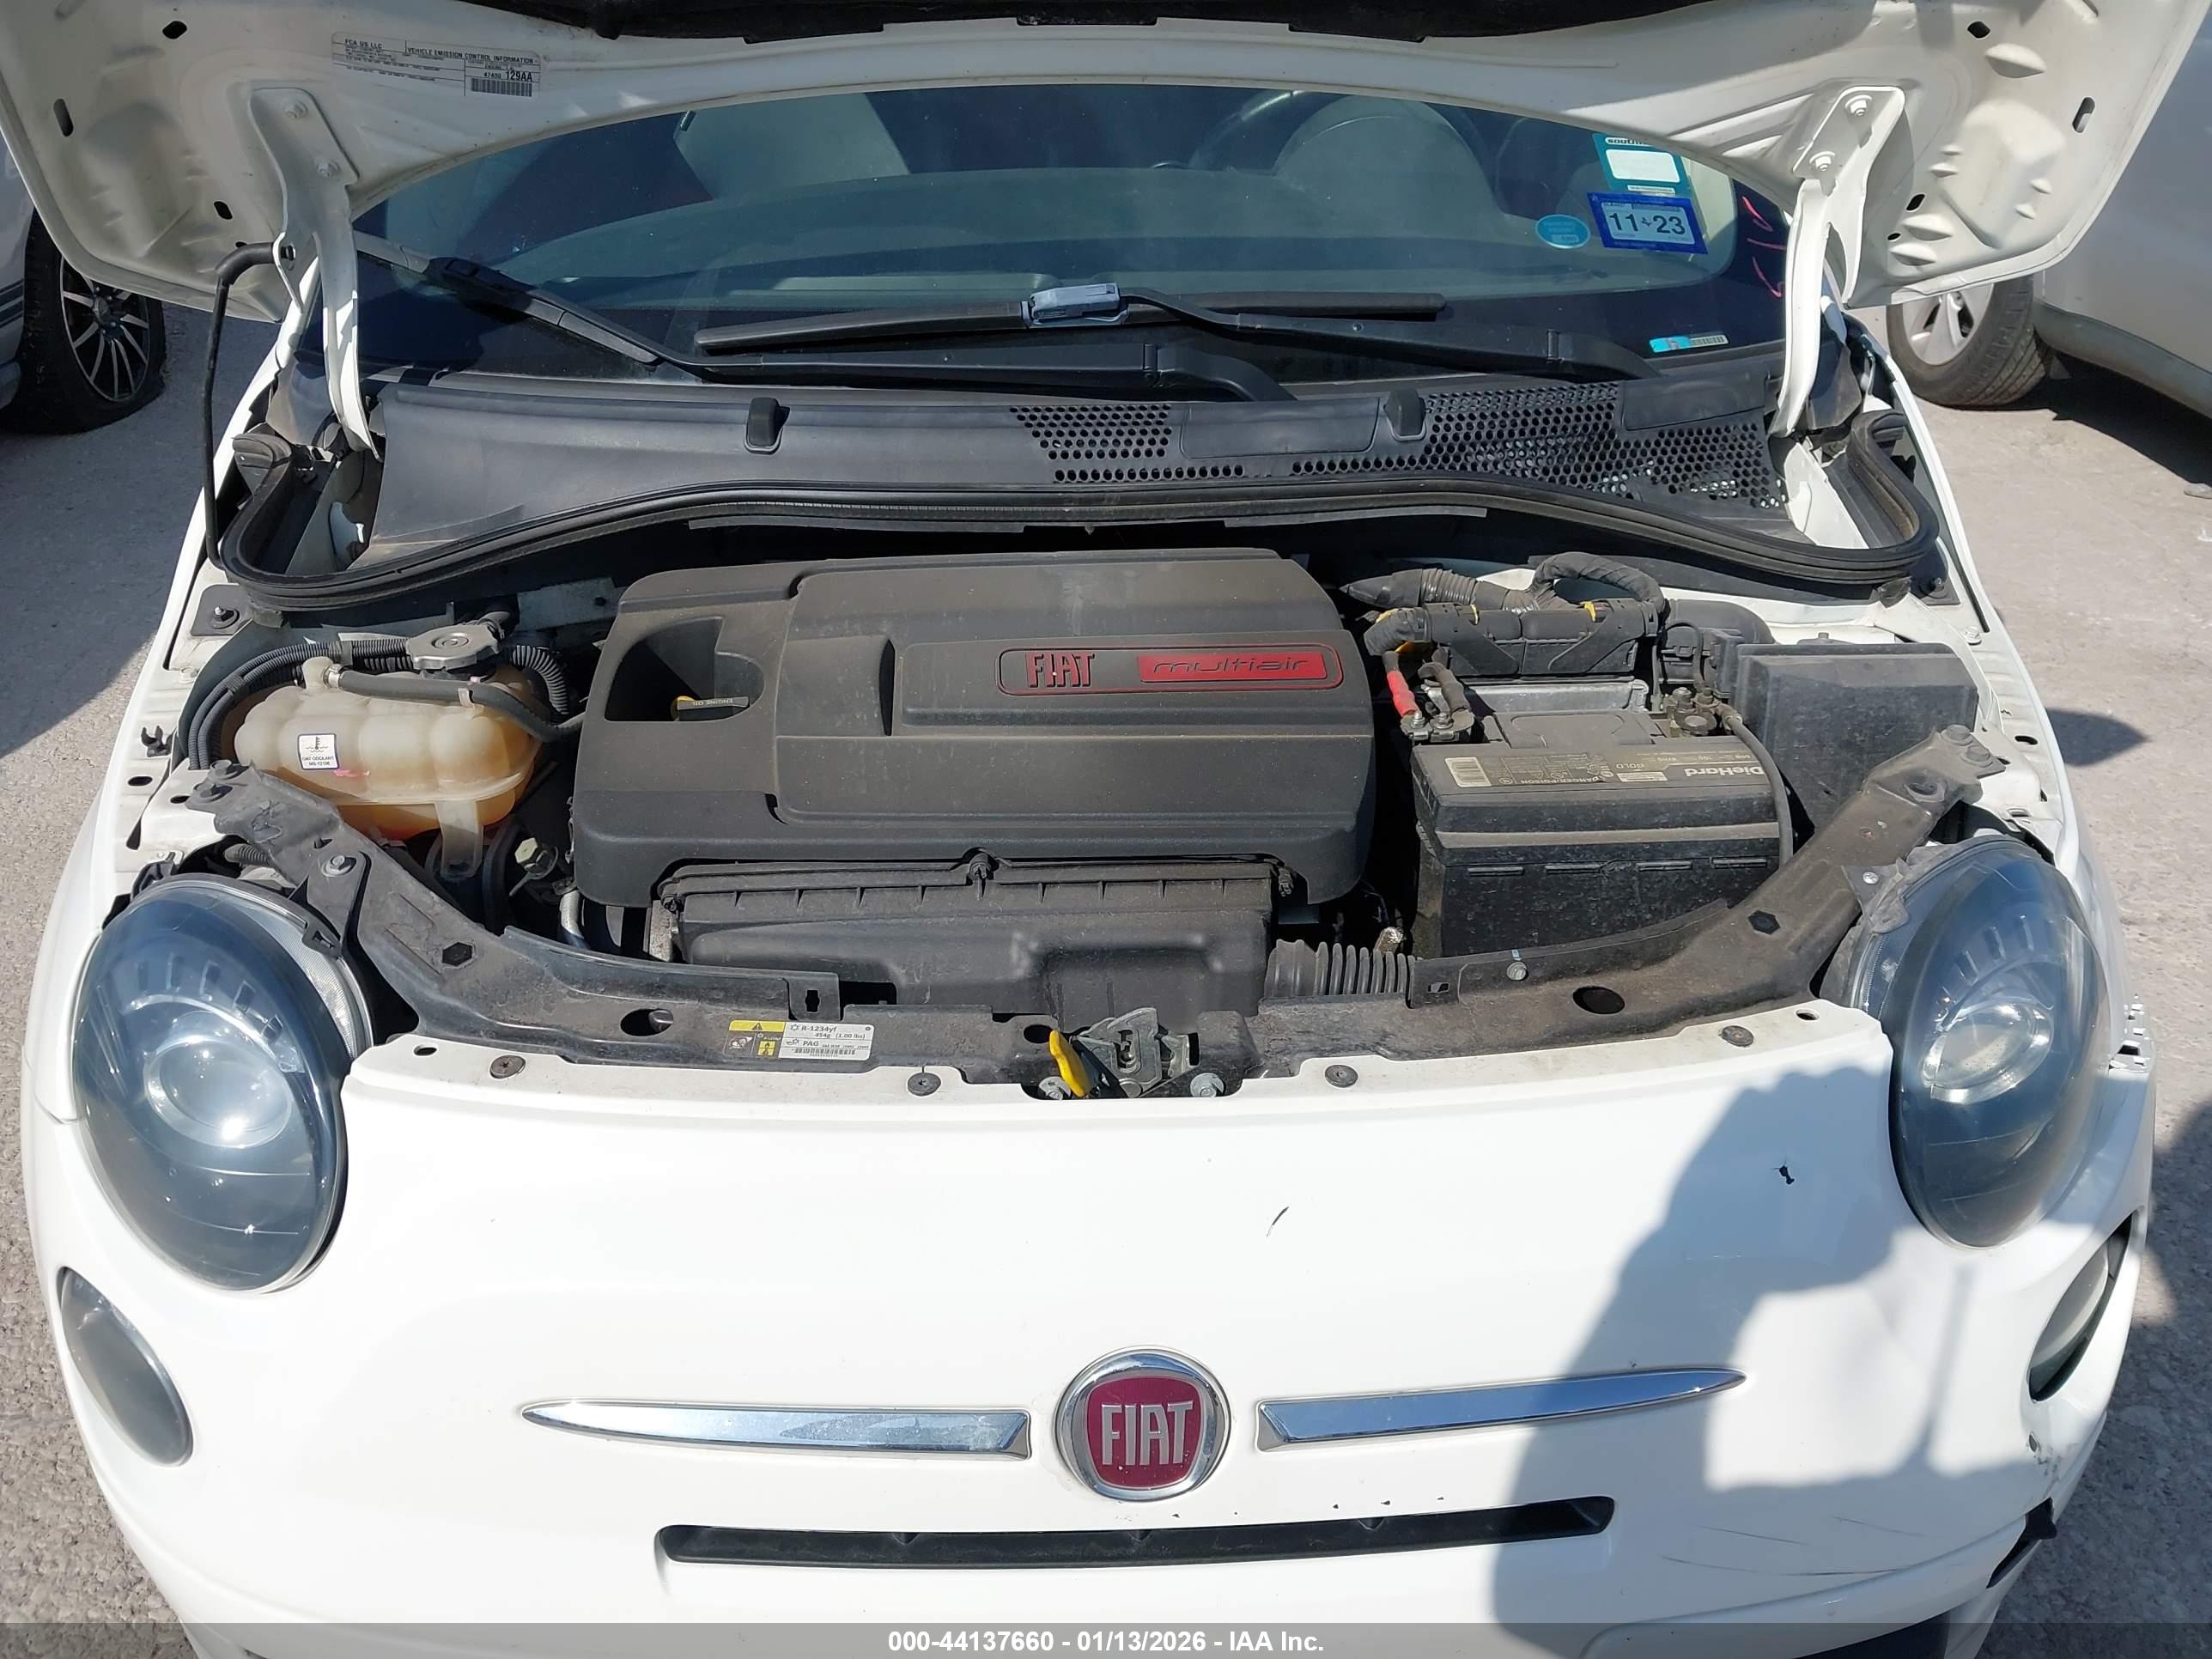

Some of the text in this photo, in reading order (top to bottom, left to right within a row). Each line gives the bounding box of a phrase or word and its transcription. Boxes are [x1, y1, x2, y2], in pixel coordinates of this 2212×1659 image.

[407, 47, 432, 56] VEHICLE
[434, 49, 463, 58] EMISSION
[465, 52, 493, 61] CONTROL
[494, 54, 533, 64] INFORMATION
[506, 70, 533, 82] 129AA
[1609, 212, 1686, 235] 11 23
[1027, 653, 1309, 688] FIAT multiair
[1684, 765, 1765, 777] DieHard
[1101, 1401, 1194, 1466] FIAT
